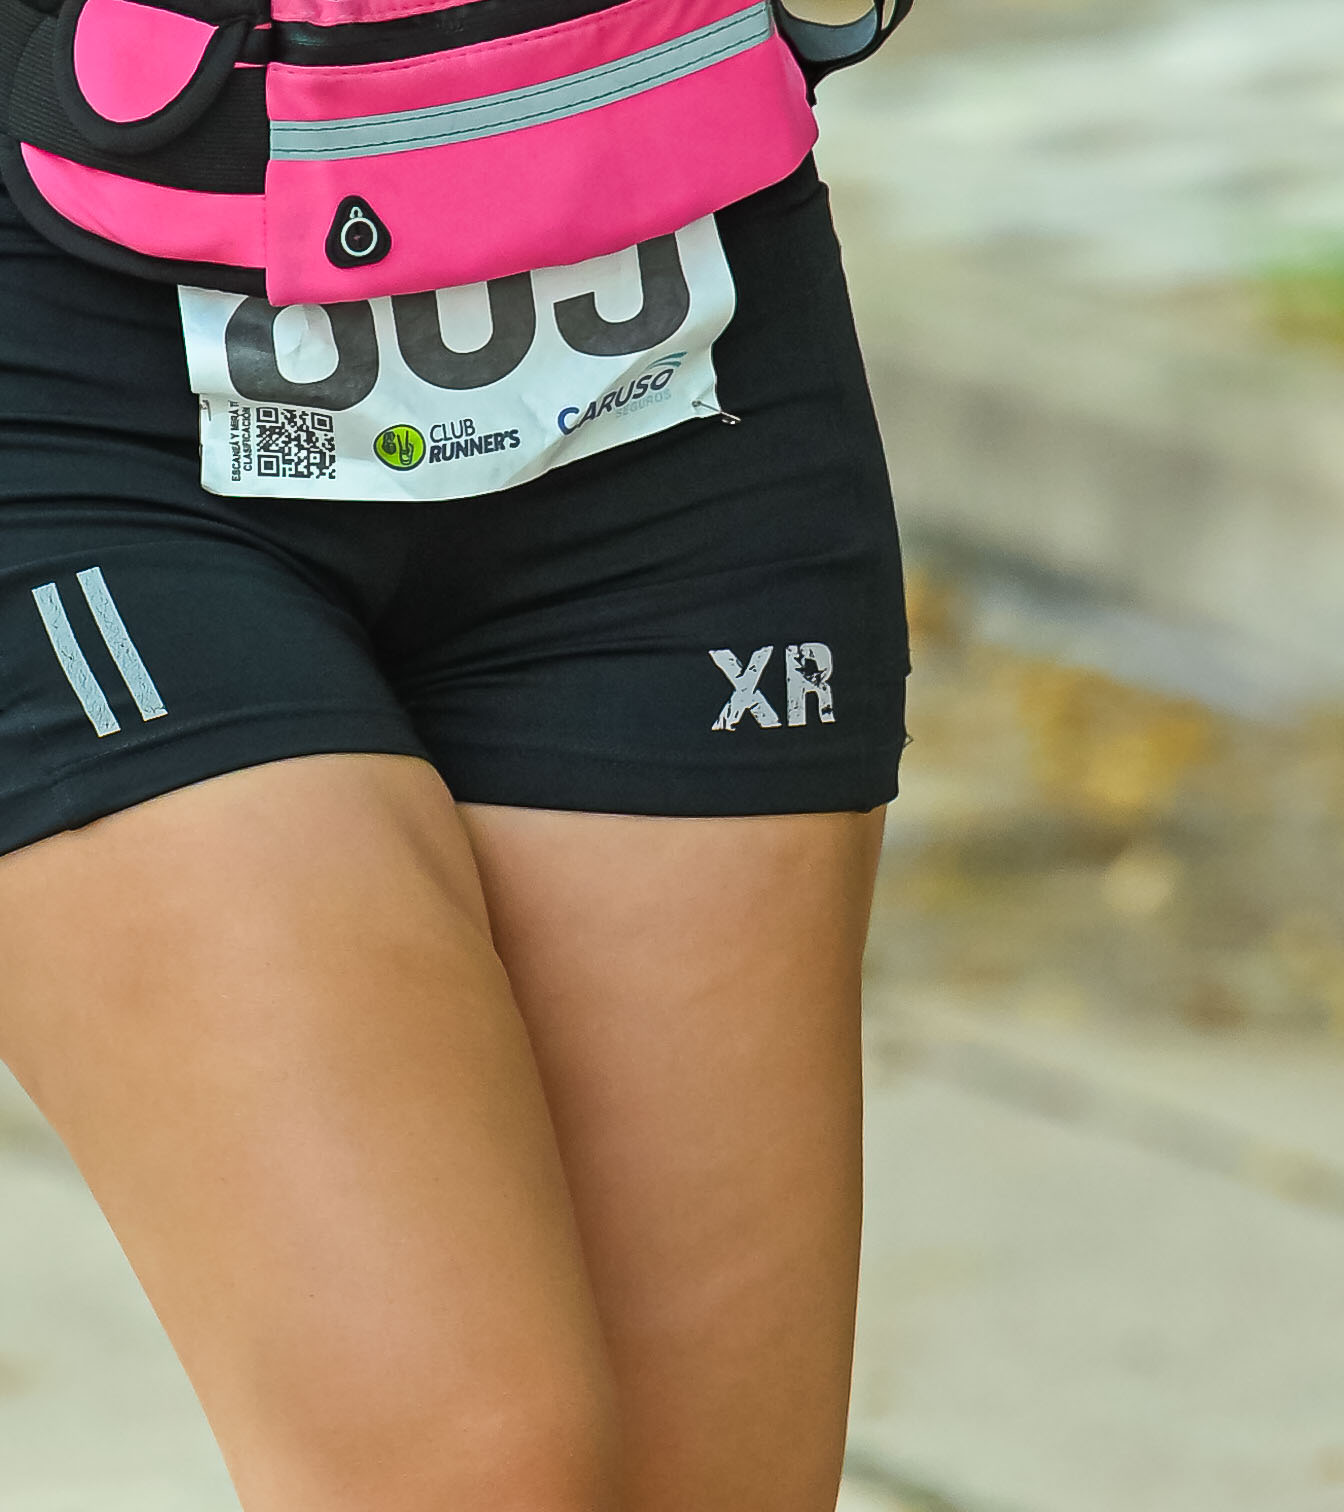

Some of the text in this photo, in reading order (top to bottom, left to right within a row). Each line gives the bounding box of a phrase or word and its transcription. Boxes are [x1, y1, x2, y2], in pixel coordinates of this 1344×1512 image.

[558, 368, 674, 435] CARUSO
[616, 389, 671, 418] SEGUROS
[429, 429, 521, 463] RUNNER'S
[430, 418, 476, 443] CLUB
[708, 642, 836, 731] XR
